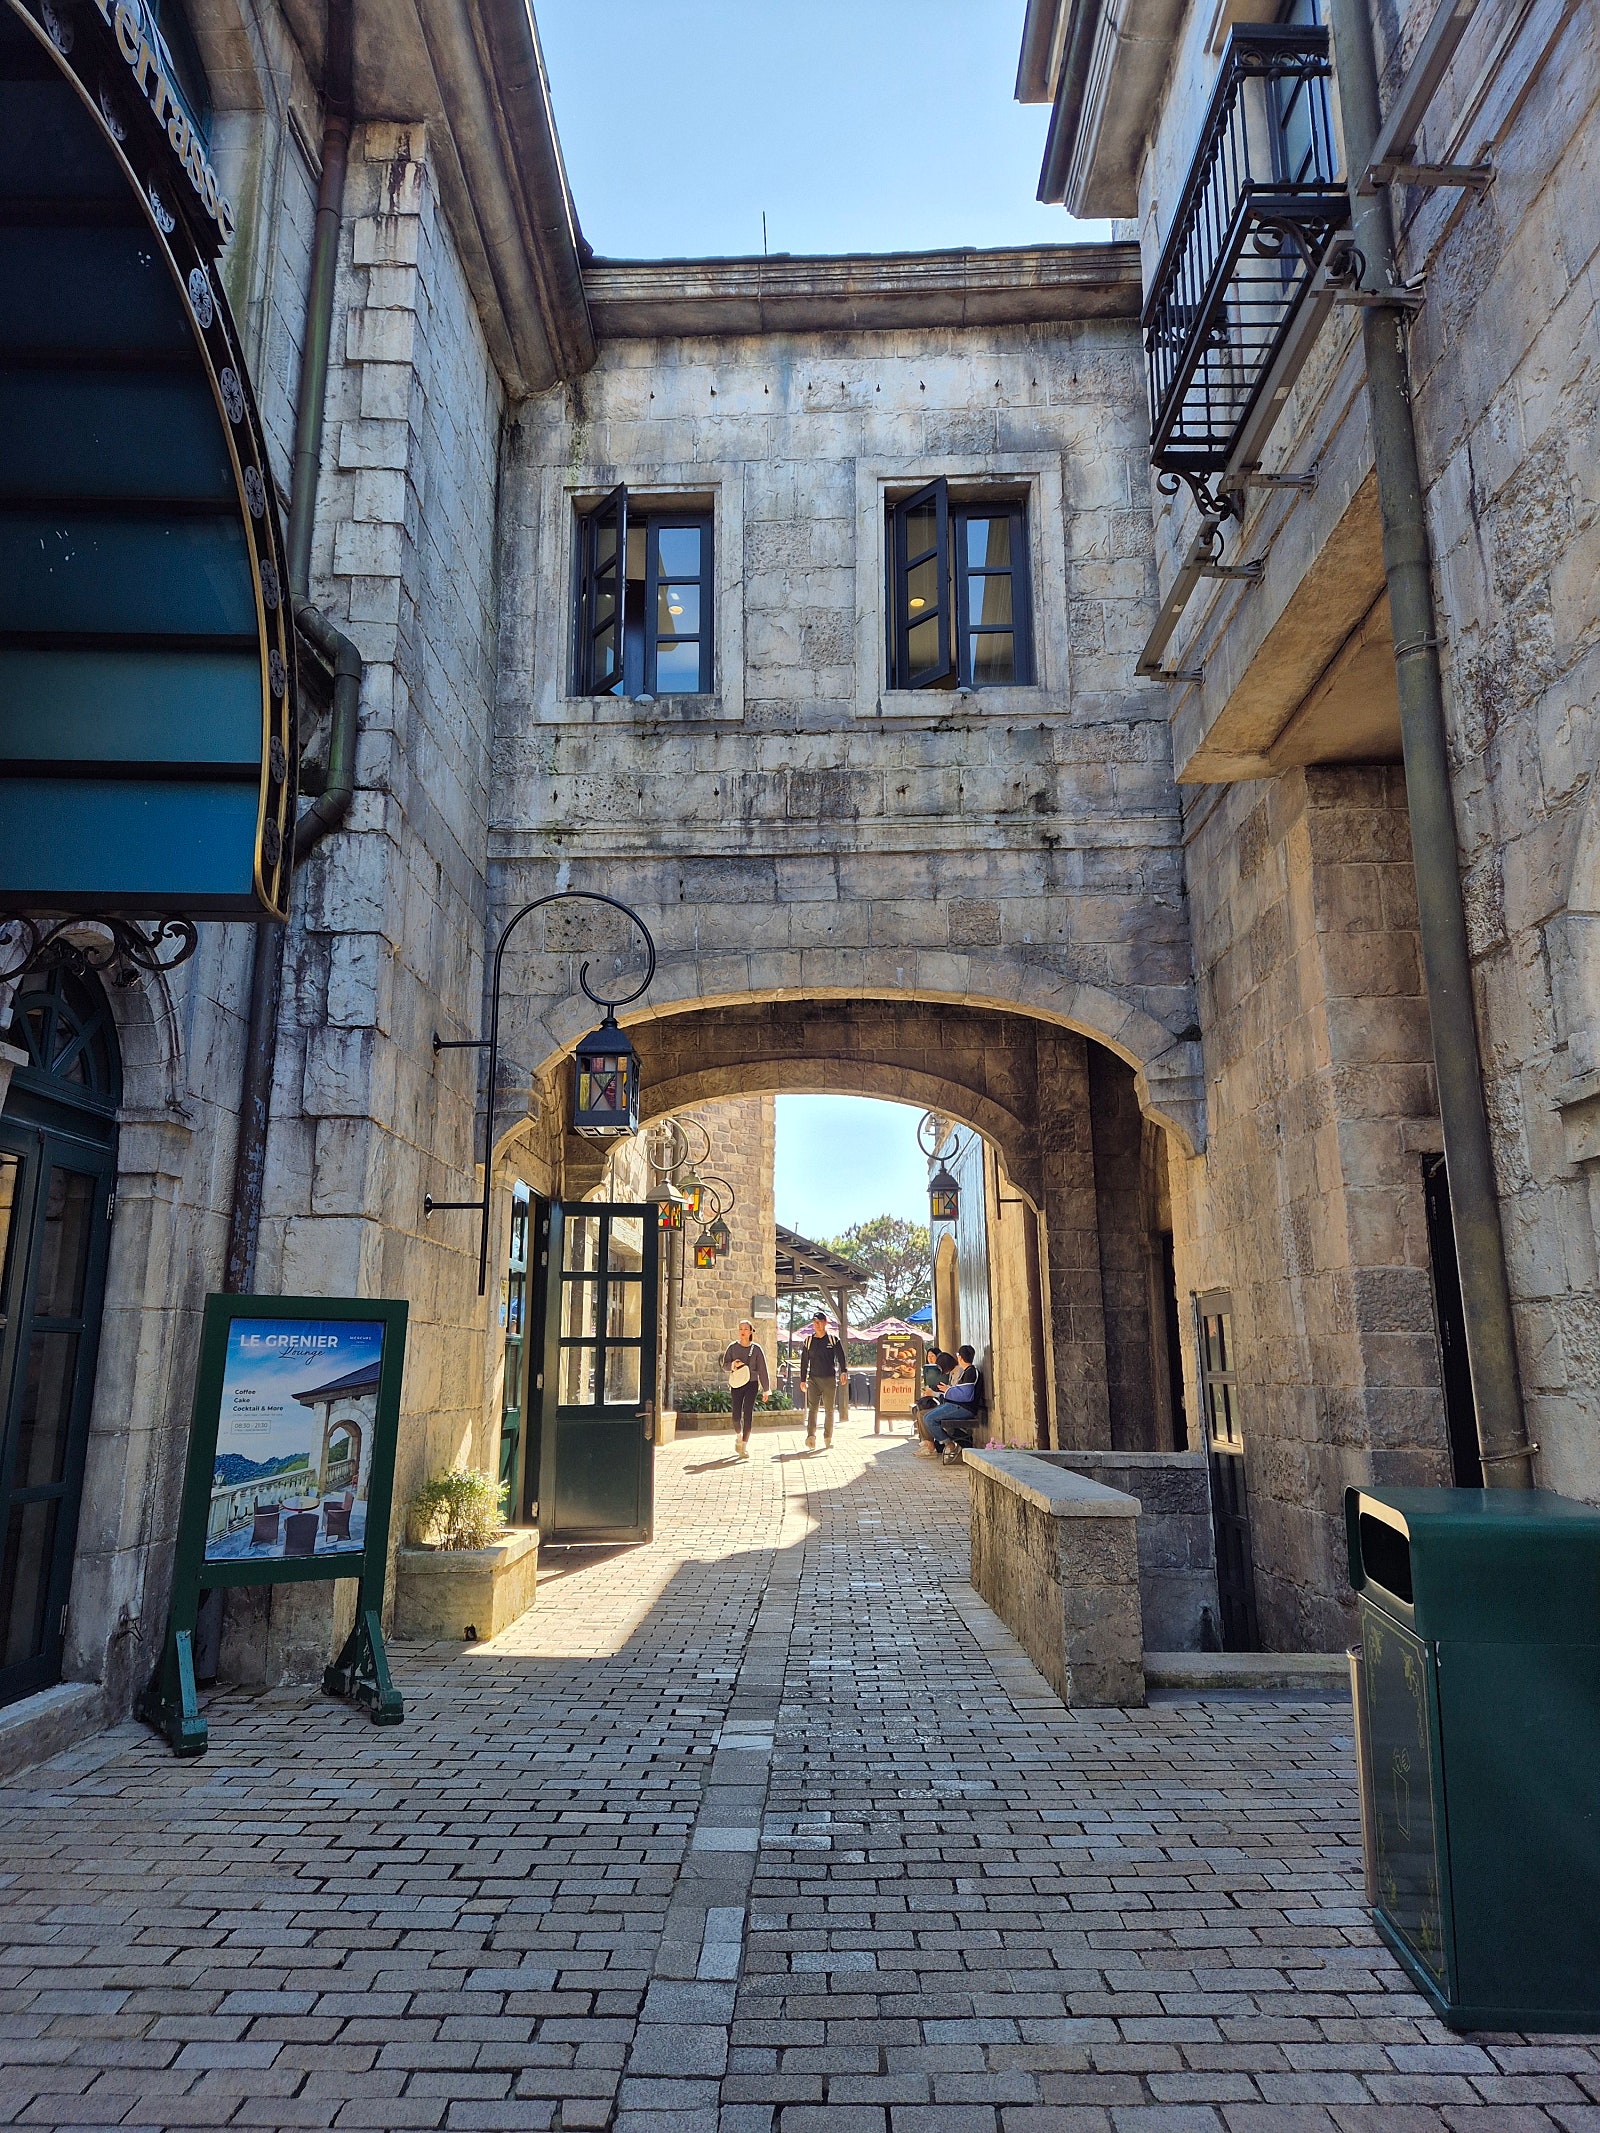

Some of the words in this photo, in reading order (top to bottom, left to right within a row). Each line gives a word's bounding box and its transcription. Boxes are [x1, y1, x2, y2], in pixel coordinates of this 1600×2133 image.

[94, 0, 236, 246] errasse
[240, 1334, 261, 1347] LE
[265, 1334, 339, 1348] GRENIER
[278, 1345, 325, 1365] Lounge
[883, 1386, 891, 1394] Le
